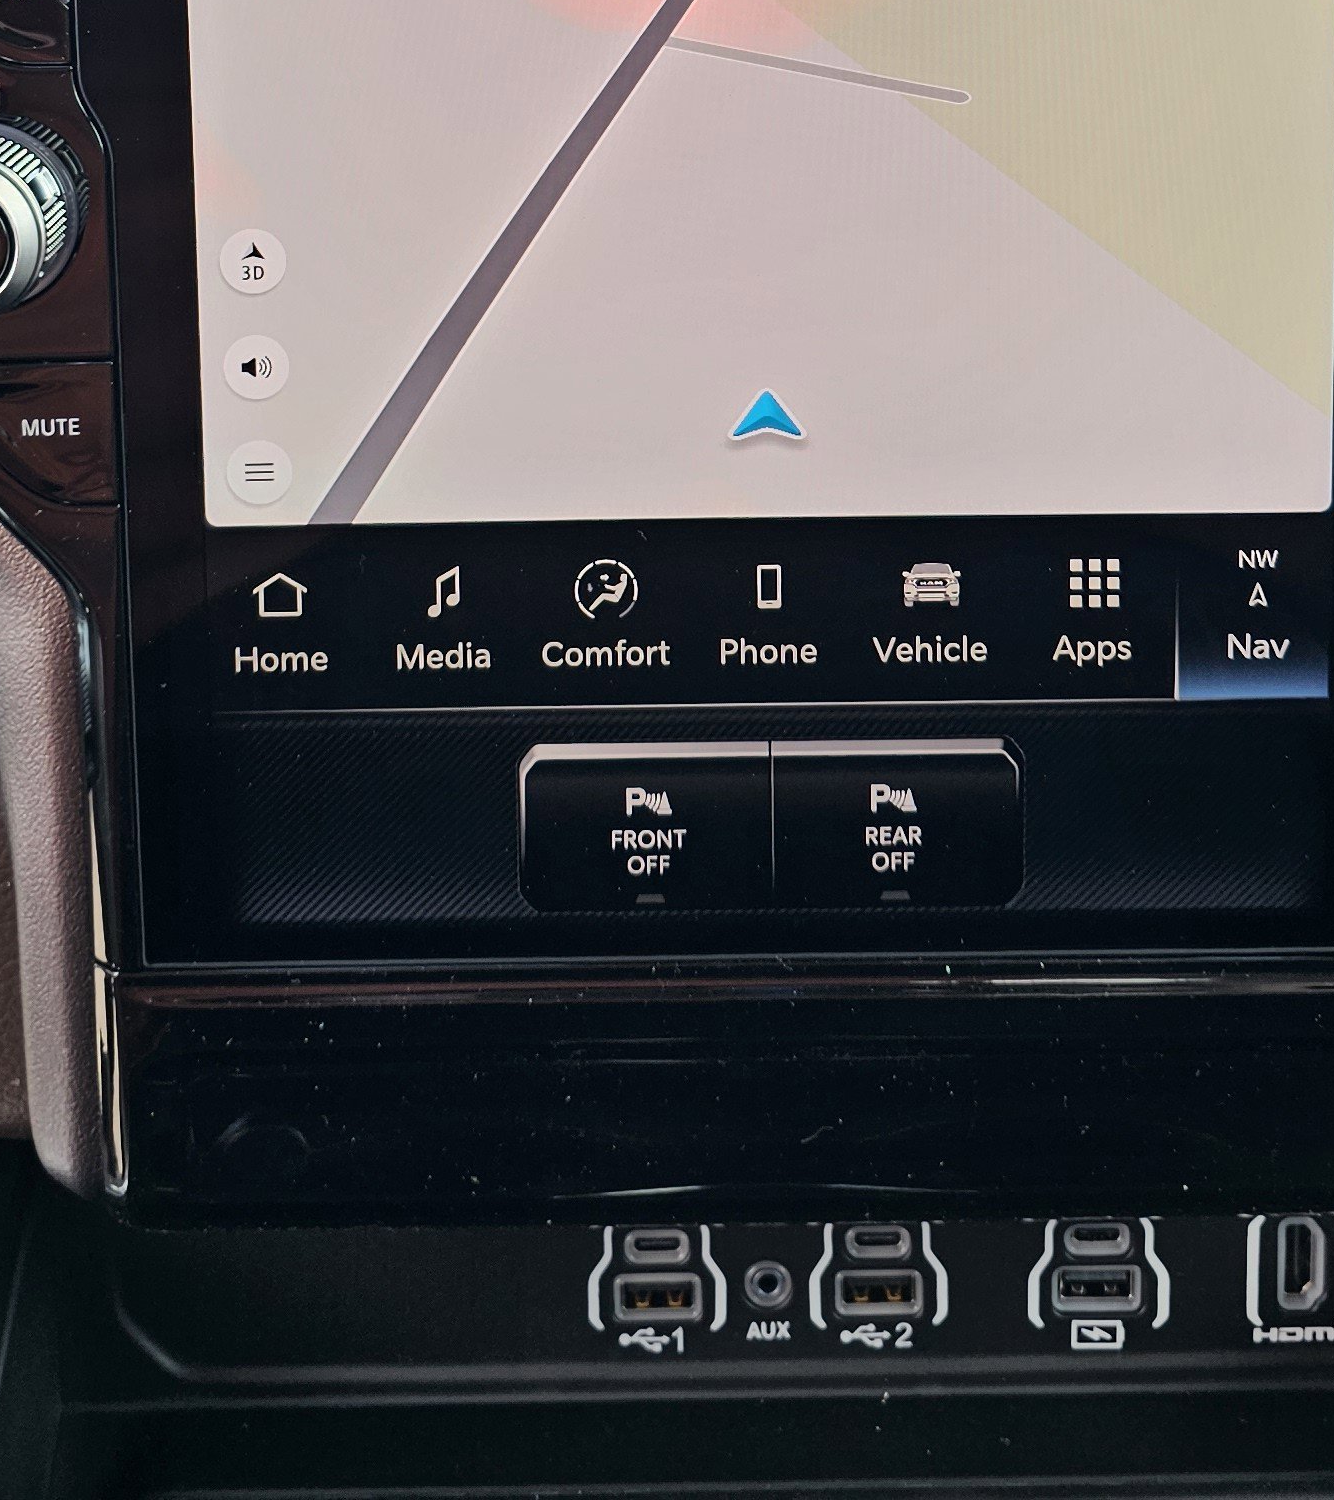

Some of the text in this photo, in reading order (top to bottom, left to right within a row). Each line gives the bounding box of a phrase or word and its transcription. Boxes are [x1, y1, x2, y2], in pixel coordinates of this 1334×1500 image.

[241, 265, 265, 281] 3D
[21, 417, 81, 437] MUTE
[1238, 549, 1279, 569] NW
[234, 646, 329, 674] Home
[395, 642, 492, 671] Media
[541, 639, 671, 669] Comfort
[720, 637, 818, 666] Phone
[872, 634, 988, 664] Vehicle
[1053, 635, 1133, 668] Apps
[1227, 633, 1290, 661] Nav
[611, 828, 687, 850] FRONT
[865, 825, 923, 847] REAR
[627, 855, 670, 877] OFF
[871, 851, 915, 873] OFF
[671, 1327, 685, 1353] 1
[745, 1321, 792, 1341] AUX
[894, 1323, 914, 1349] 2
